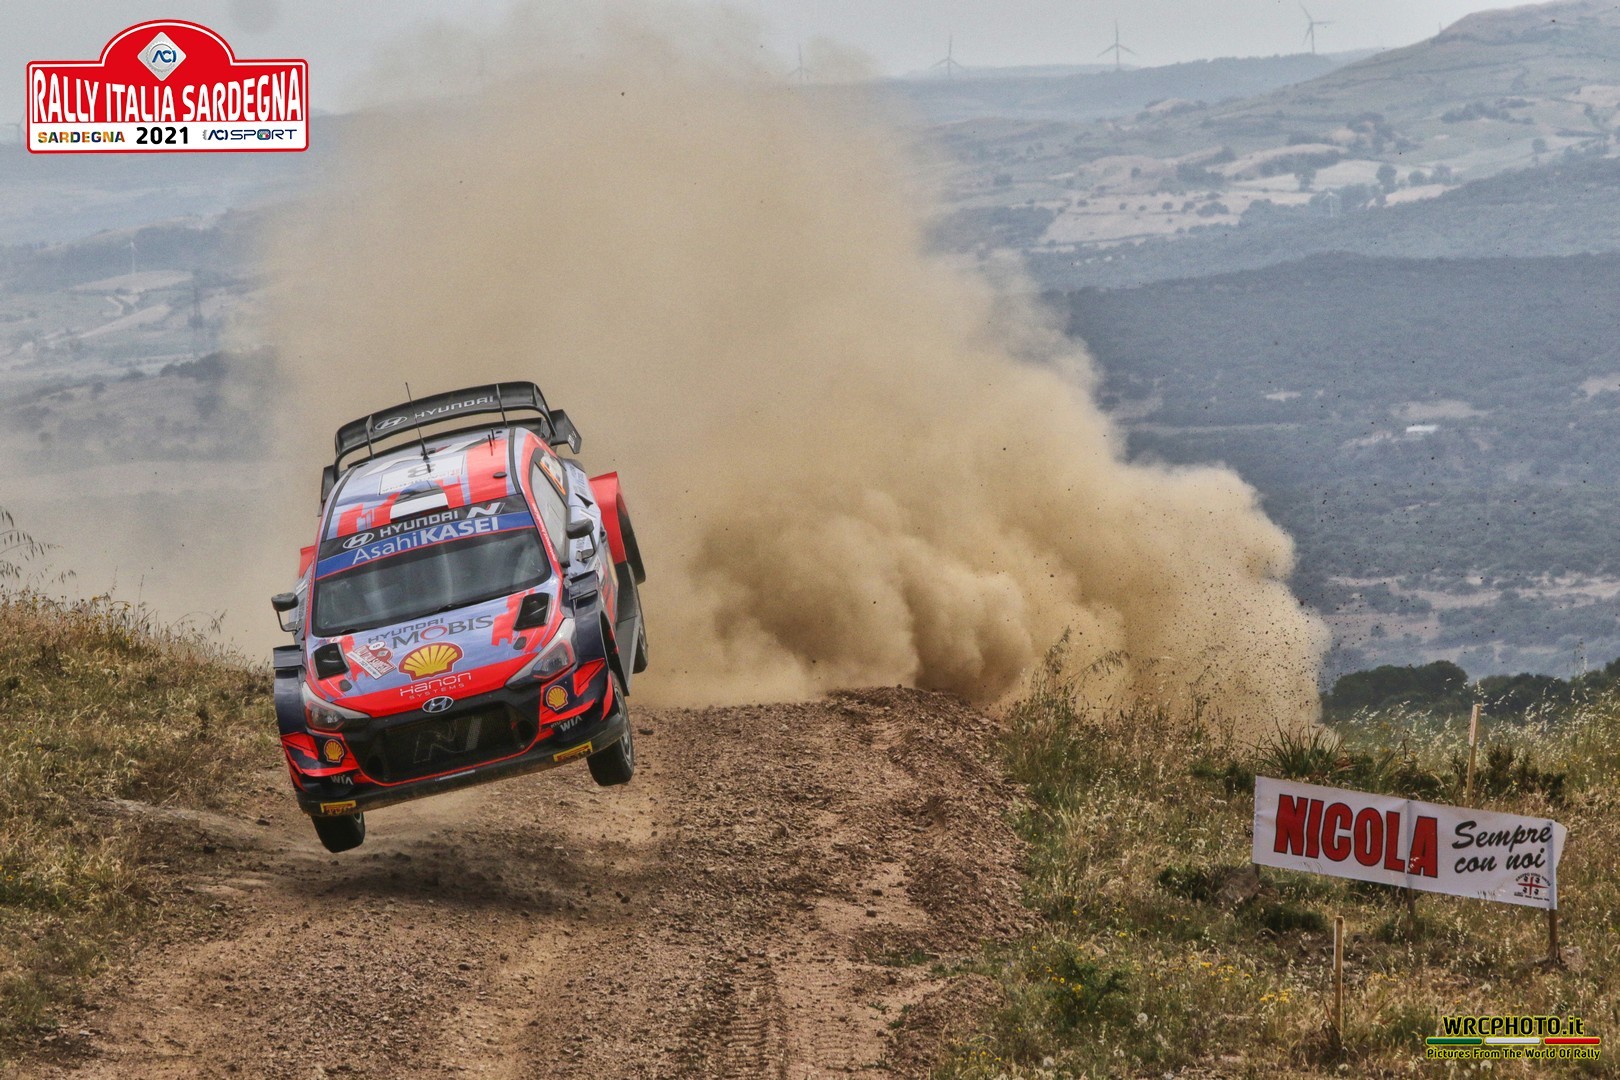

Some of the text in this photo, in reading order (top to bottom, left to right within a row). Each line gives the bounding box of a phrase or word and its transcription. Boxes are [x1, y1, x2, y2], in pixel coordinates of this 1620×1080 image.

[414, 395, 494, 420] HYUNDAI
[379, 510, 459, 538] HYUNDAI
[368, 617, 444, 643] HYUNDAI
[392, 614, 494, 649] MOBIS
[408, 683, 465, 700] SYSTEMS
[1273, 793, 1439, 878] NICOLA
[1451, 820, 1553, 852] Sempre
[1454, 847, 1546, 874] con noi
